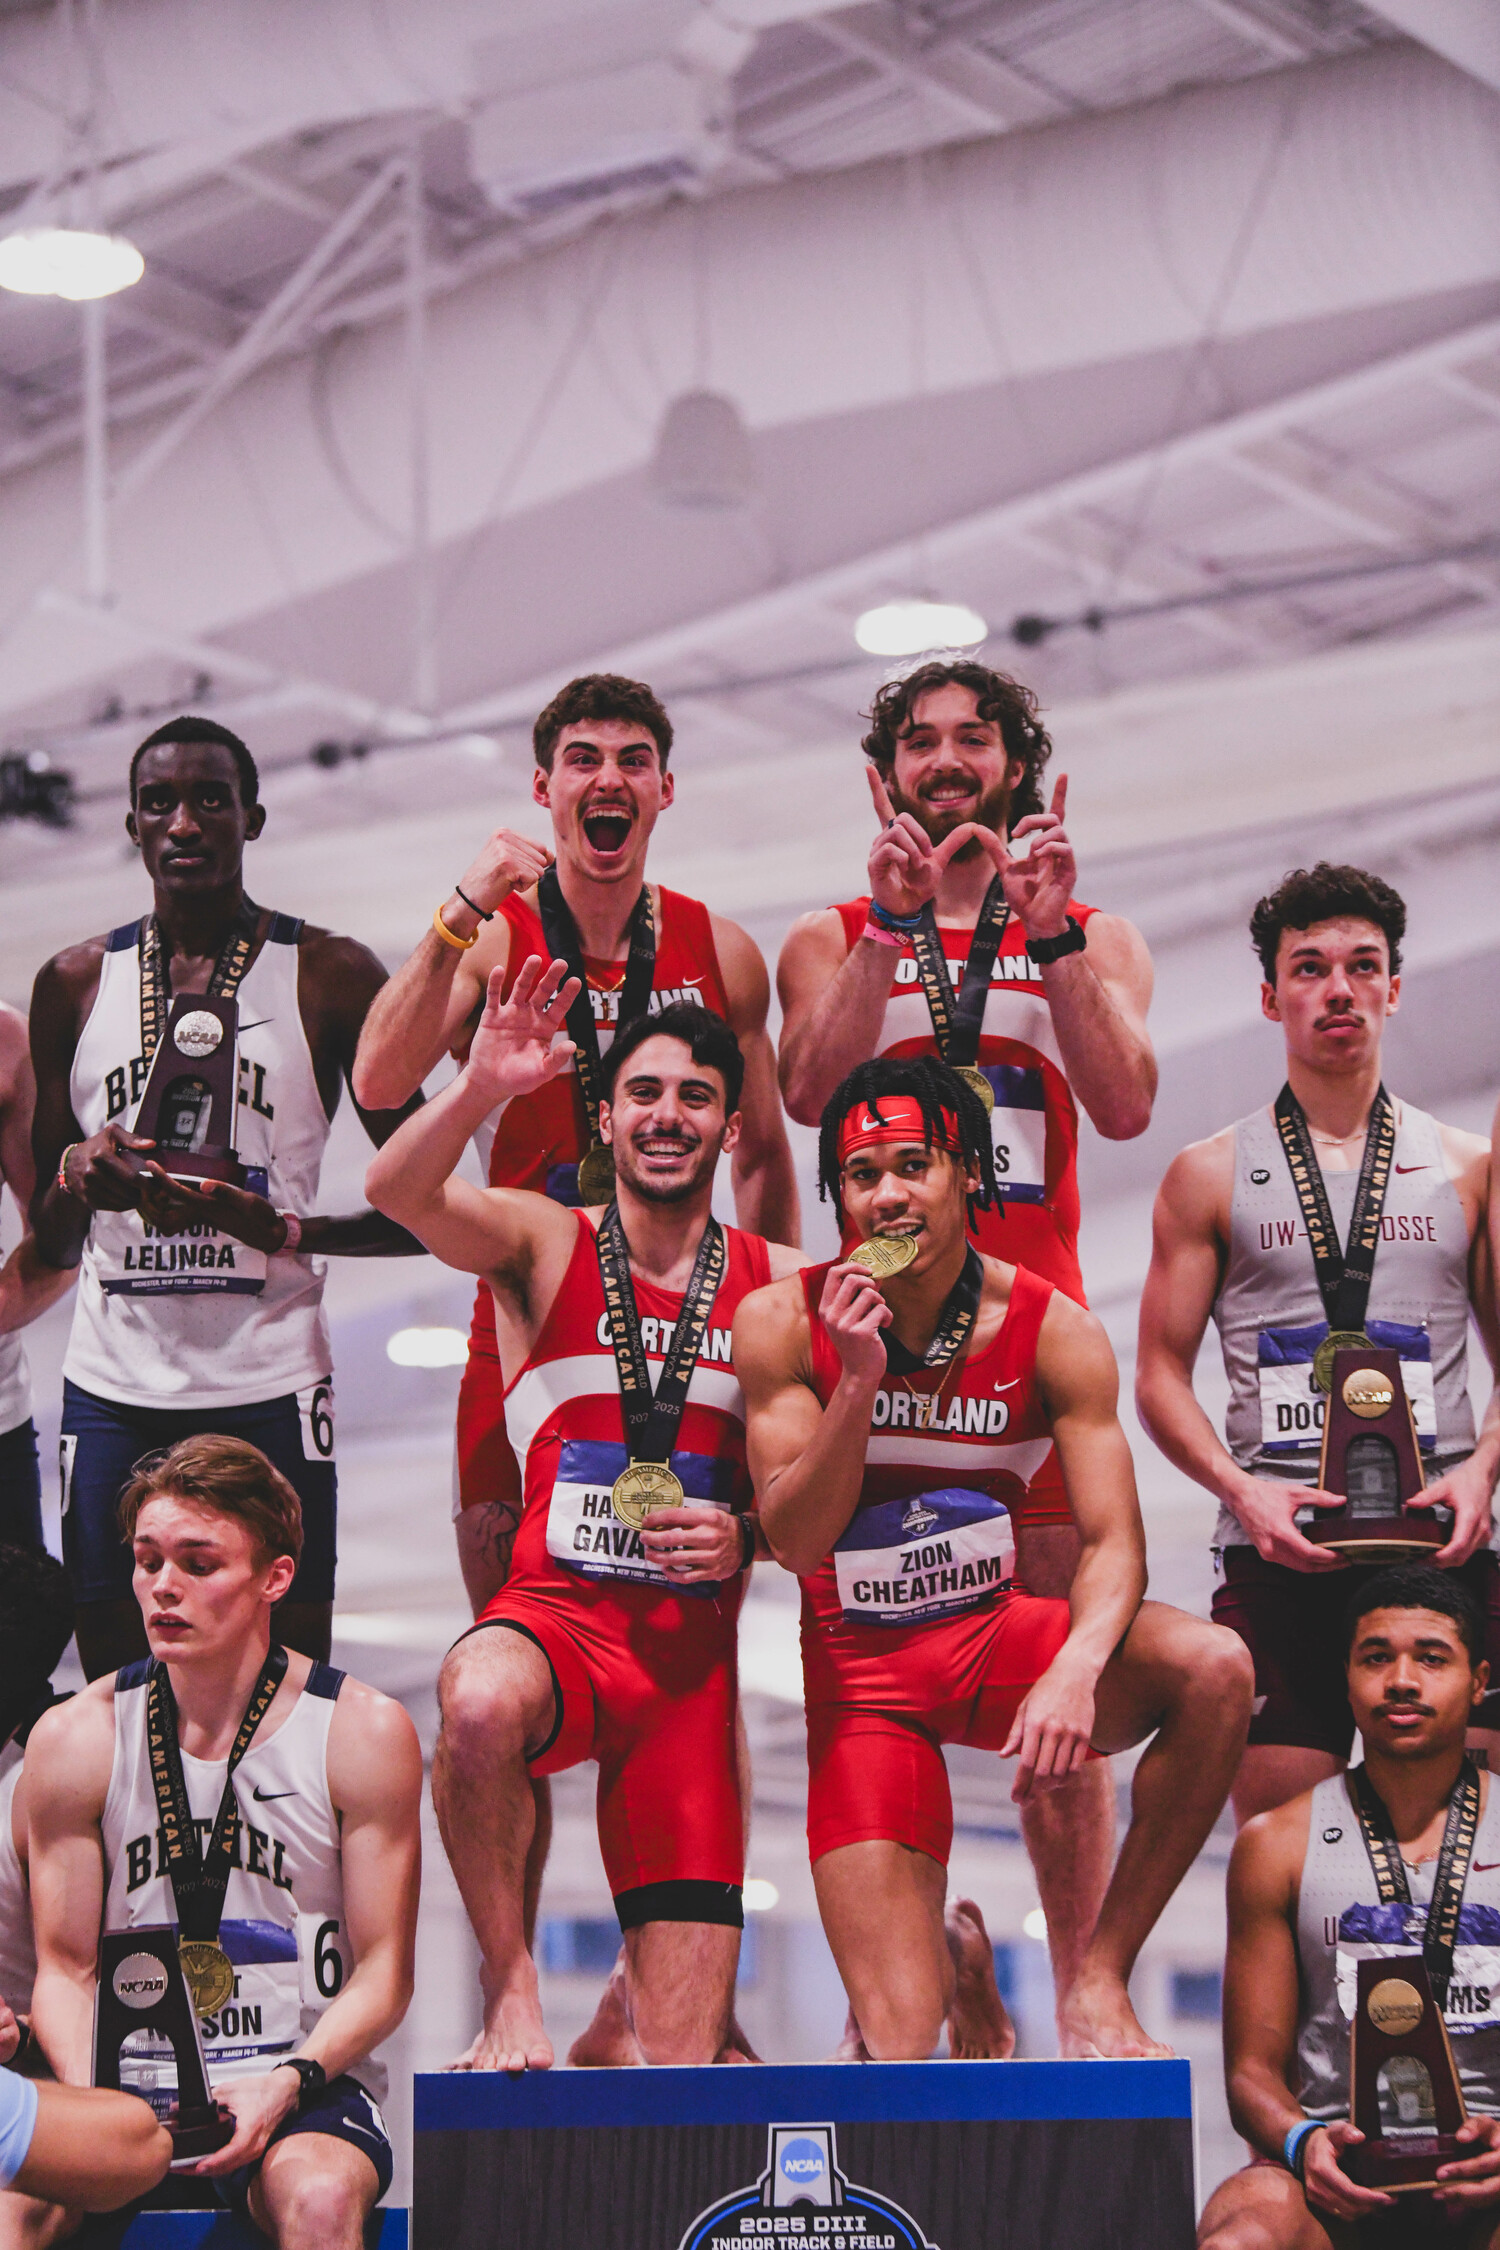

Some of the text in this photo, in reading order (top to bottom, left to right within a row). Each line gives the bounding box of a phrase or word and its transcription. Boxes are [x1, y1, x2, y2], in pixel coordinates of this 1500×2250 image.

[973, 940, 998, 950] 2025
[142, 929, 157, 1062] ALL-AMERICA
[1253, 1172, 1268, 1180] DF
[1279, 1116, 1329, 1259] ALL-AMERICAN
[1361, 1100, 1393, 1250] ALL-AMERICAN
[611, 1224, 623, 1247] NCAA
[124, 1244, 235, 1271] LELINGA
[615, 1247, 629, 1282] DIVISION
[1344, 1268, 1371, 1282] 2025
[599, 1231, 636, 1391] ALL-AMERICAN
[623, 1293, 637, 1328] INDOOR
[662, 1354, 676, 1378] NCAA
[670, 1317, 687, 1353] DIVISION
[684, 1276, 700, 1308] INDOOR
[693, 1252, 707, 1275] TRACK
[676, 1236, 723, 1383] ALL-AMERICAN
[630, 1330, 642, 1355] TRACK
[923, 1334, 943, 1359] TRACK
[637, 1365, 648, 1388] FIELD
[653, 1400, 680, 1415] 2025
[871, 1390, 1008, 1434] ORTLAND
[312, 1387, 333, 1456] 6
[901, 1541, 952, 1574] ZION
[617, 1568, 630, 1576] NEW
[853, 1556, 1001, 1605] CHEATHAM
[149, 1680, 183, 1859] ALL-AMERICAN
[1324, 1829, 1341, 1839] DF
[1439, 1785, 1478, 1946] ALL-AMERICAN
[315, 1920, 343, 1998] 6
[119, 1977, 165, 1994] NCAA
[222, 2049, 243, 2058] MARCH
[784, 2159, 824, 2174] NCAA
[740, 2215, 867, 2234] 2025 DIII
[711, 2235, 895, 2250] INDOOR TRACK & FIELD
